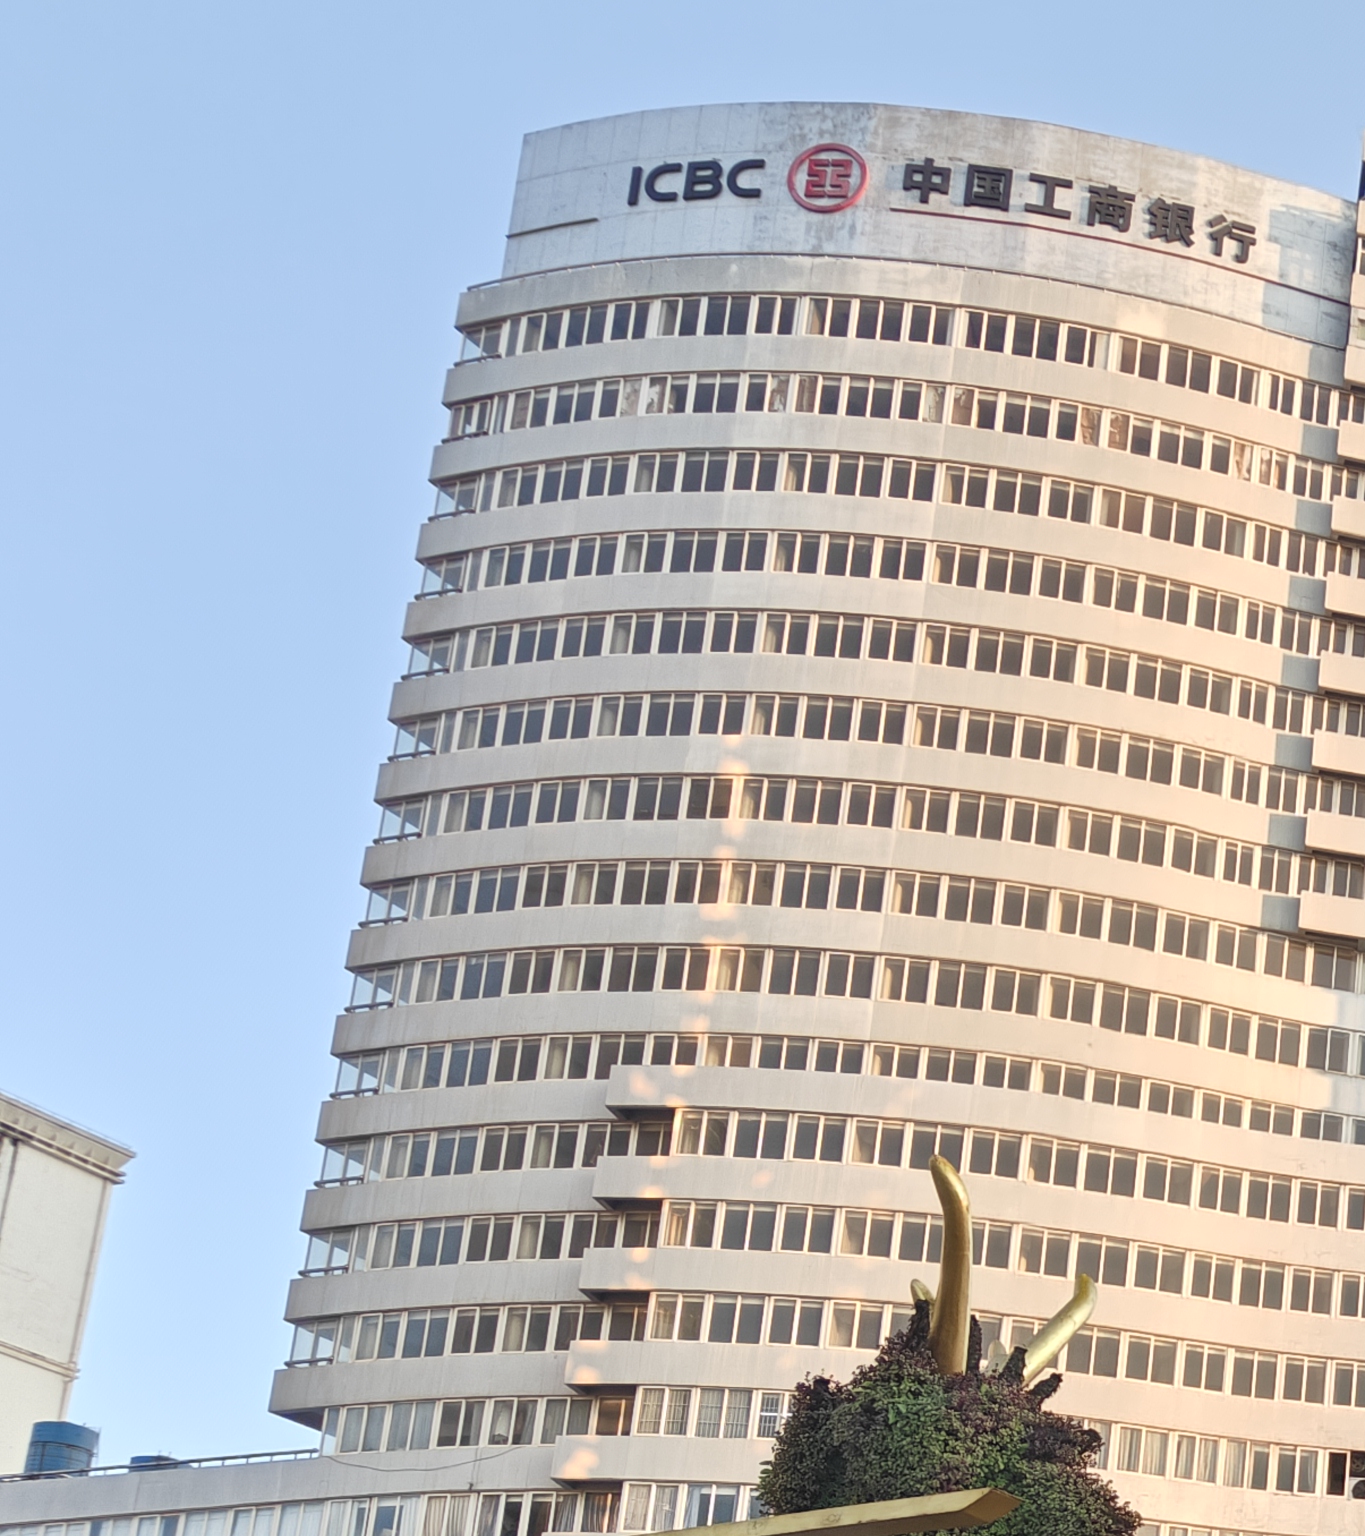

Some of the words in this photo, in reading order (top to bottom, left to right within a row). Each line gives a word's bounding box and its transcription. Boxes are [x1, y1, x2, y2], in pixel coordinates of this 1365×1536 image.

[627, 158, 766, 206] ICBC
[902, 157, 1258, 264] 中国工商银行
